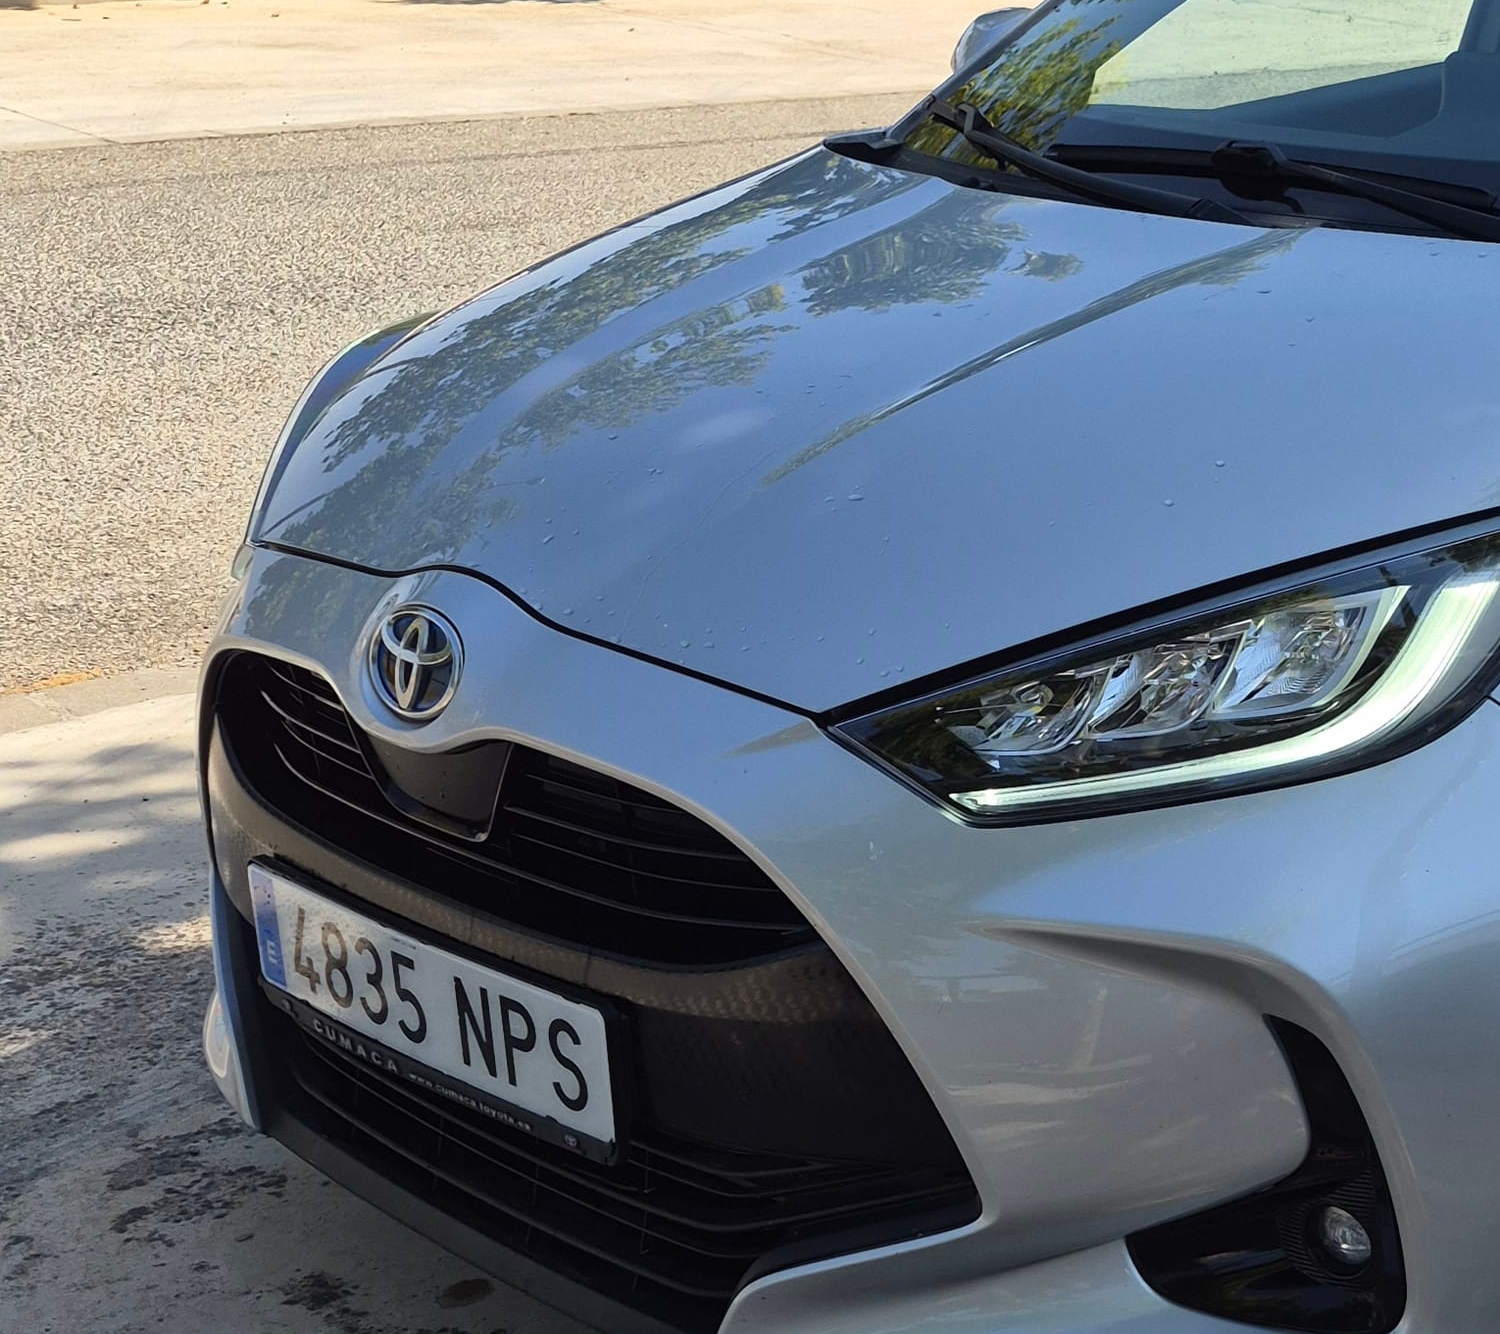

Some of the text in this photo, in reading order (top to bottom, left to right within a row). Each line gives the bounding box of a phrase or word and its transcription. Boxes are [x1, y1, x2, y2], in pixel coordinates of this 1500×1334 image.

[266, 939, 279, 964] E
[293, 906, 589, 1112] 4835 NPS
[312, 1018, 399, 1072] CUMACA
